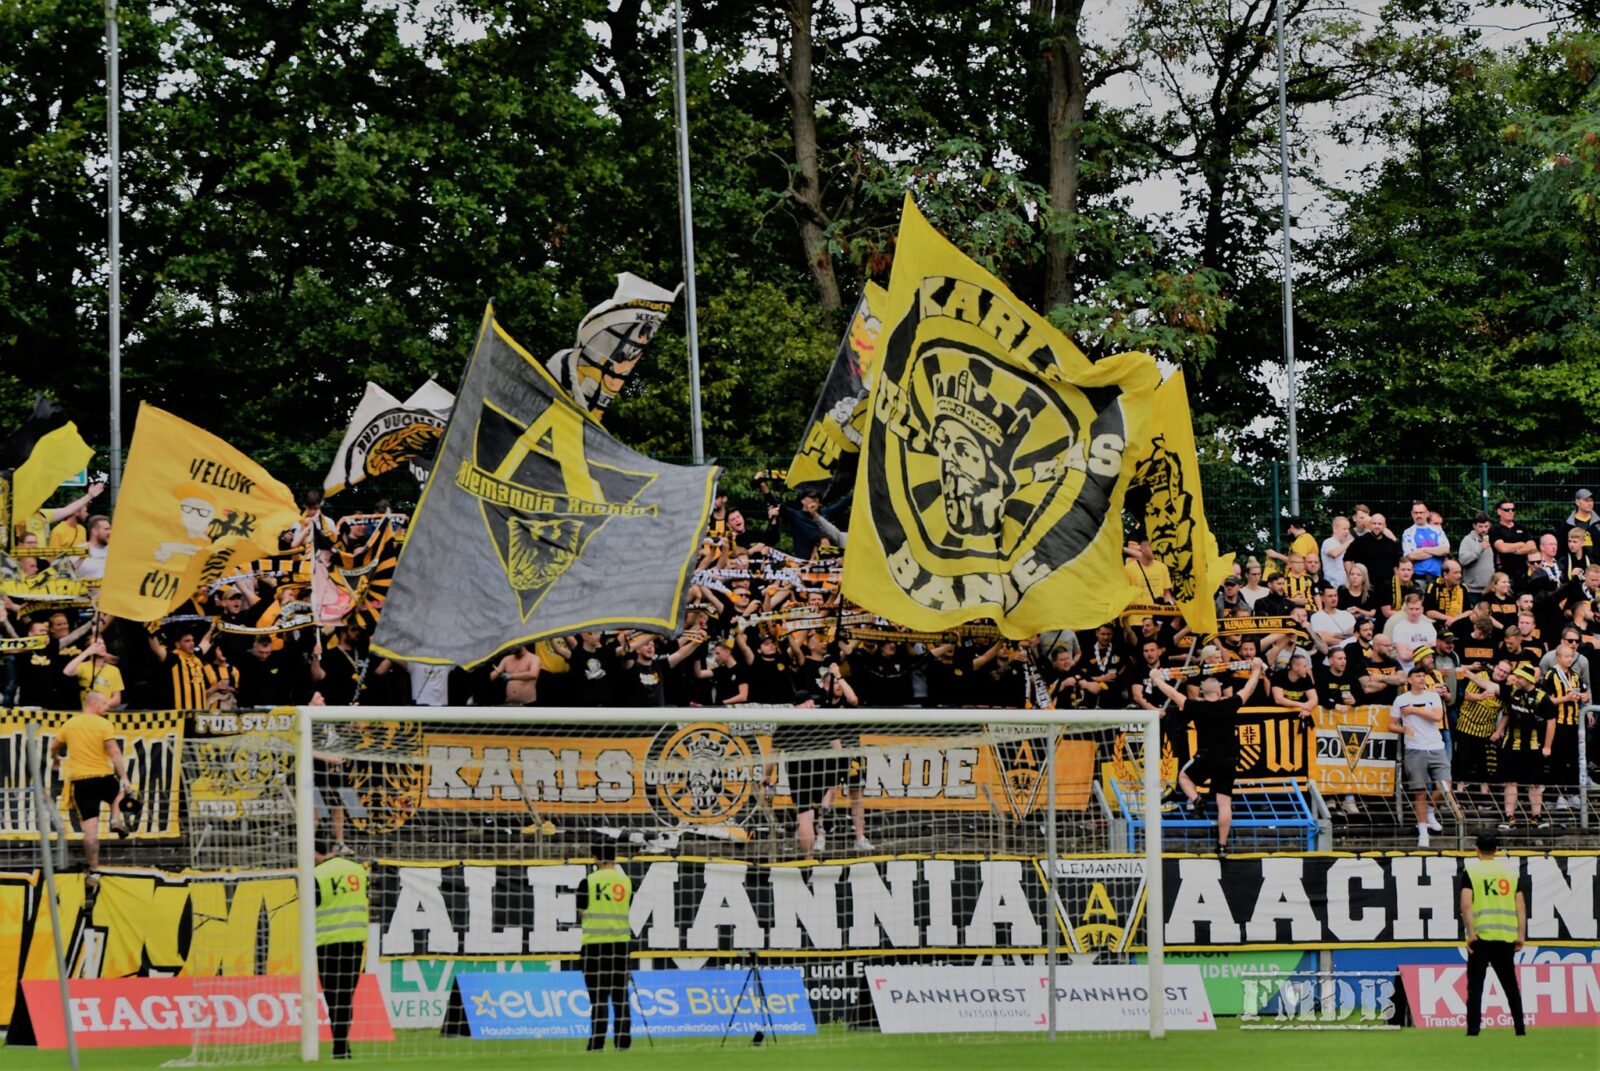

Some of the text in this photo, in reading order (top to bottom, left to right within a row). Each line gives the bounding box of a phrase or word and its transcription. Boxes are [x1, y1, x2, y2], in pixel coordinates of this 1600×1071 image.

[197, 714, 239, 732] FÜR
[428, 745, 636, 803] KARLS
[331, 875, 361, 896] K9
[595, 882, 626, 903] K9
[1483, 878, 1510, 897] K9
[1164, 856, 1598, 945] AACHN
[811, 962, 848, 978] und
[686, 987, 800, 1015] Bücker
[890, 988, 1026, 1004] PANNHORST
[1056, 986, 1188, 1002] PANNHOST
[959, 1009, 1031, 1018] ENTSORGUNG
